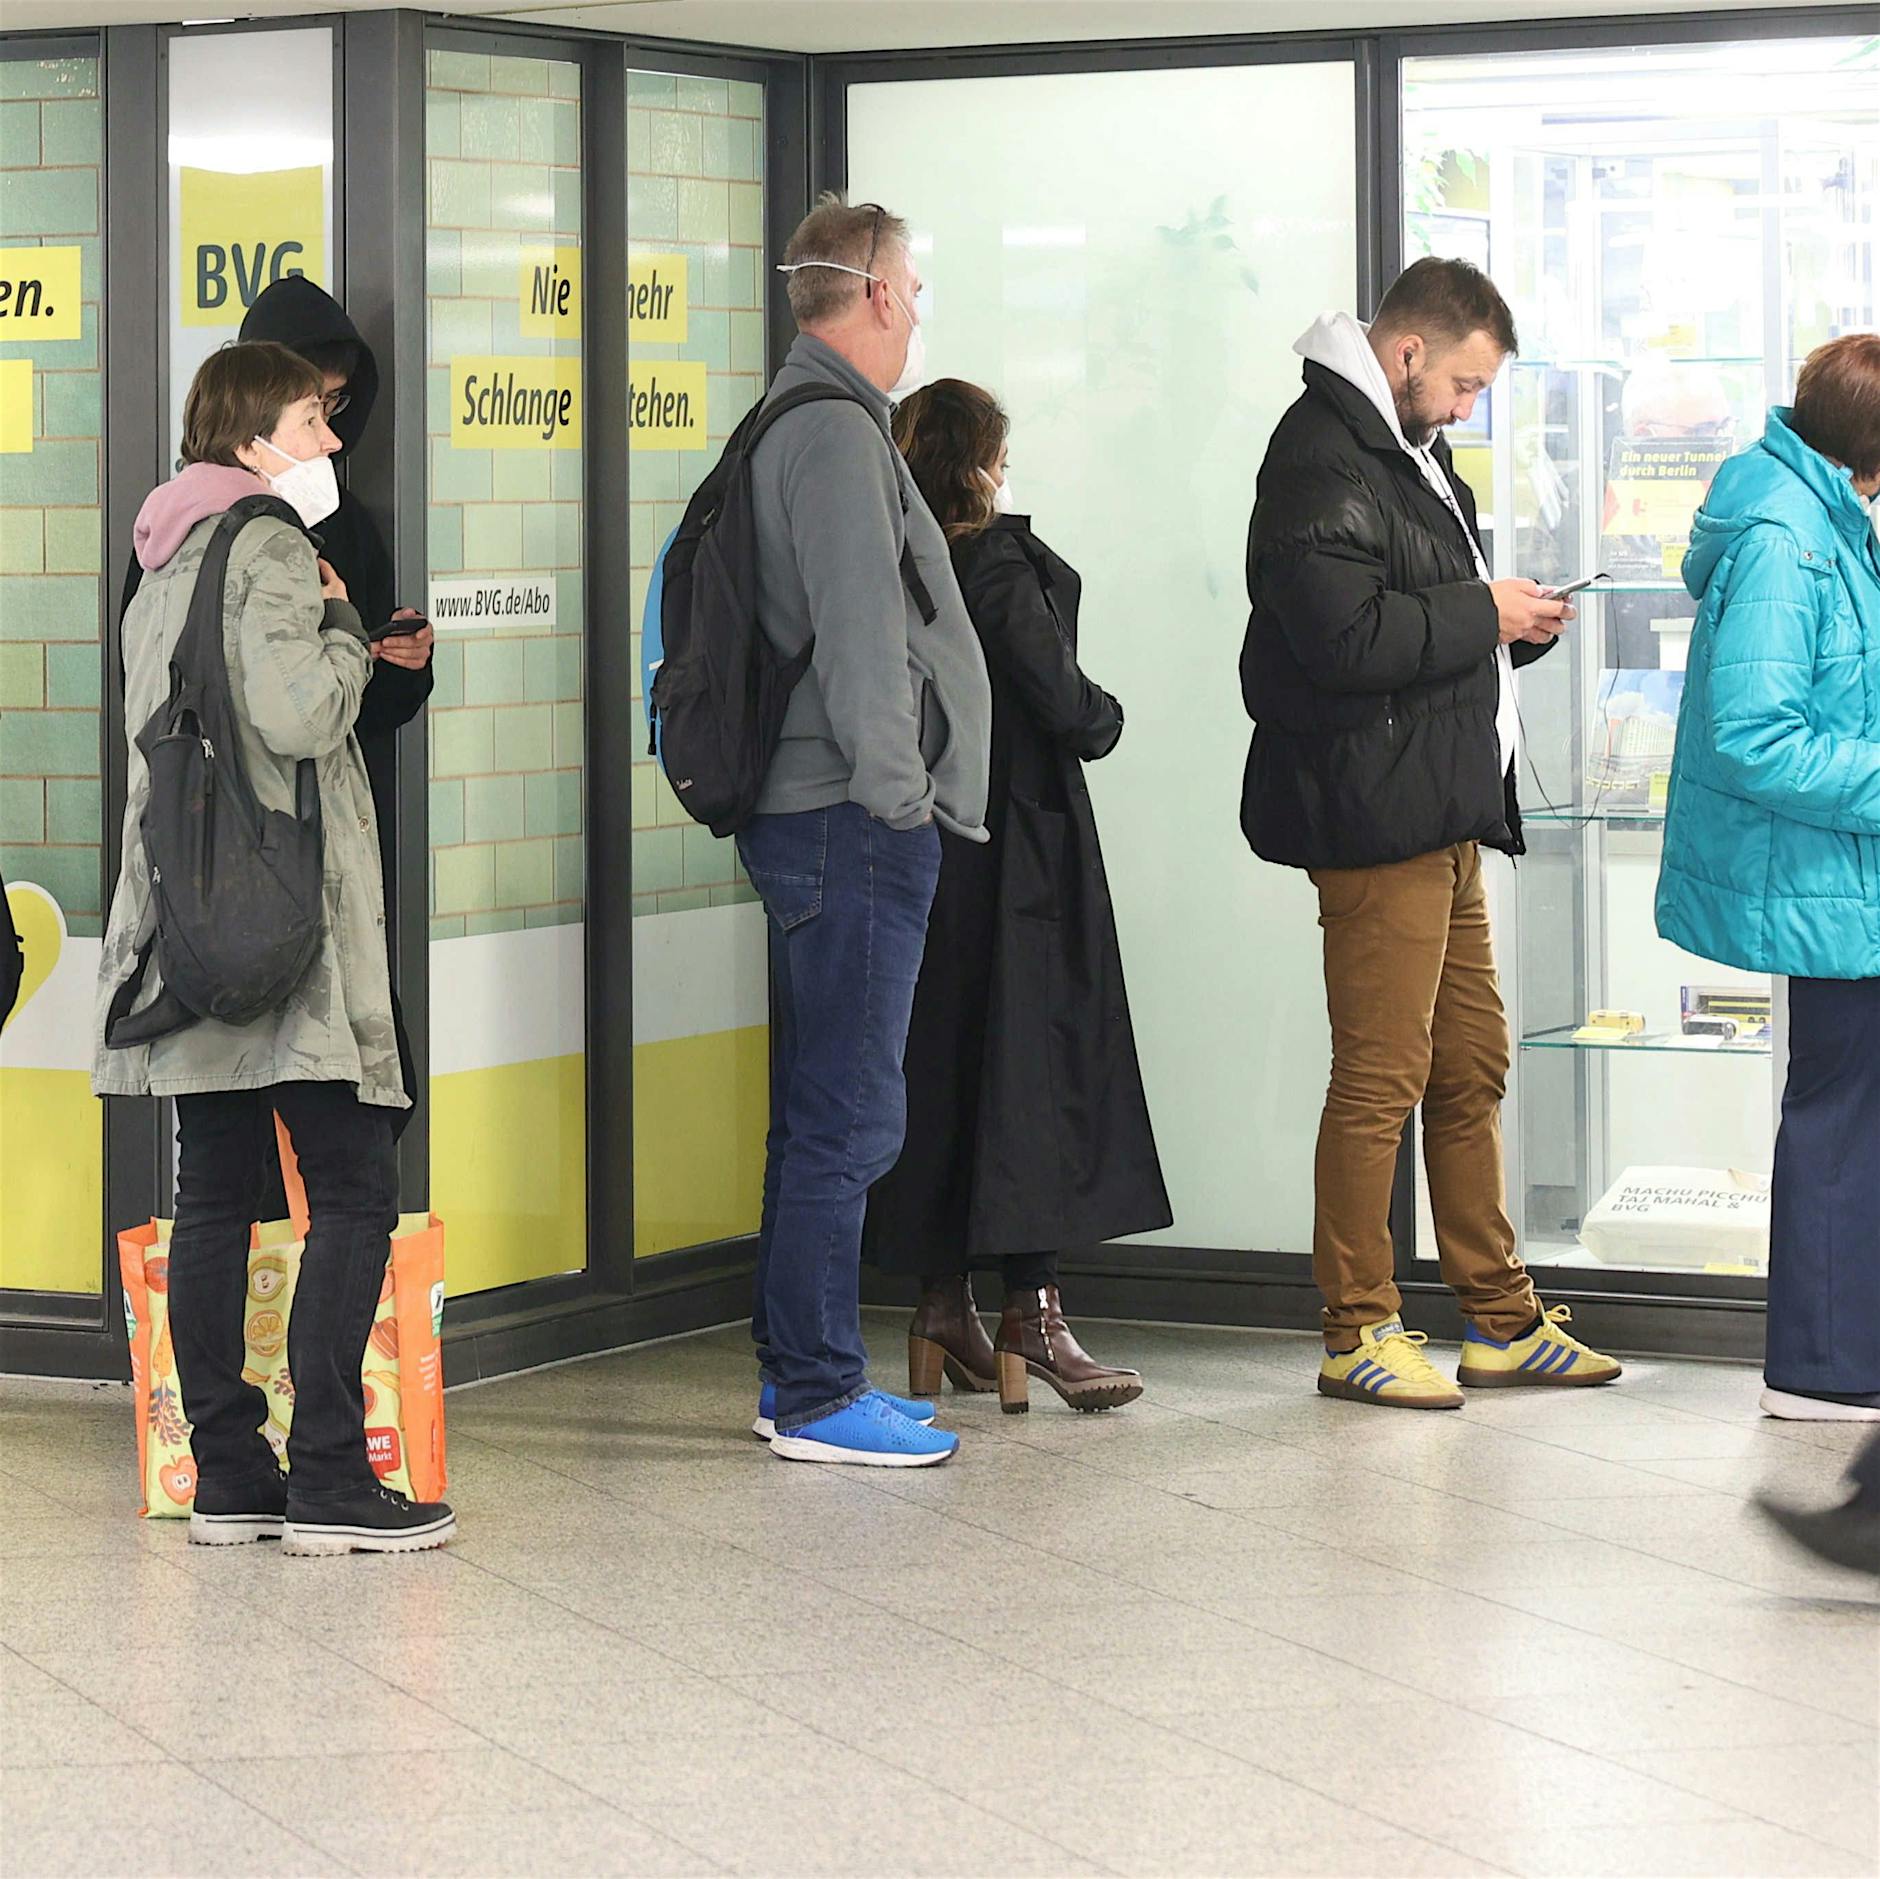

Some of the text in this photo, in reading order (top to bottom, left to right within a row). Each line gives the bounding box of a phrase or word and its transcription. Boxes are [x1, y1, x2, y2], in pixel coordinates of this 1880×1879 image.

[531, 264, 571, 316] Nie
[462, 372, 694, 441] Schlange tehen.
[1621, 451, 1642, 463] Ein
[1643, 453, 1682, 463] neuer
[1620, 464, 1697, 477] durch Berlin
[436, 586, 550, 618] www.BVG.de/Abo
[1618, 1194, 1741, 1210] TAJ MAHAL &
[1622, 1186, 1768, 1204] MACHU PICCHU
[1611, 1203, 1650, 1213] BVG
[366, 1434, 392, 1451] WE
[368, 1451, 393, 1463] Markt
